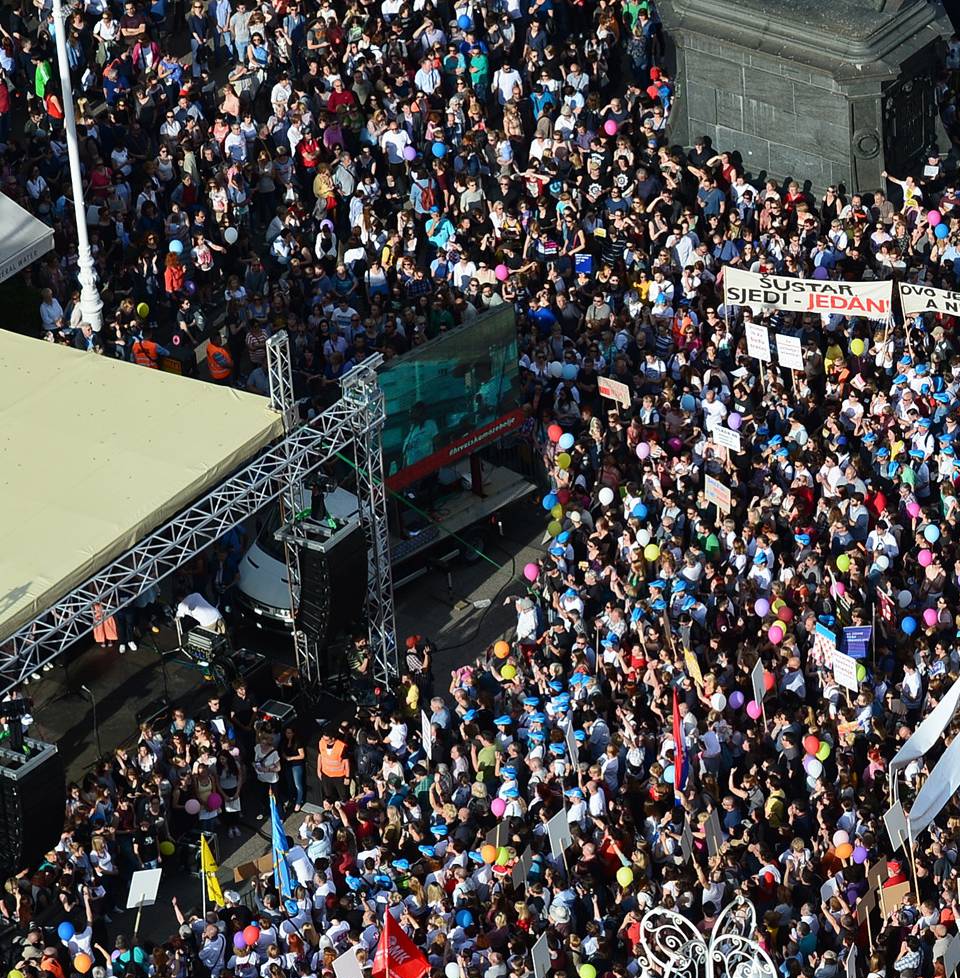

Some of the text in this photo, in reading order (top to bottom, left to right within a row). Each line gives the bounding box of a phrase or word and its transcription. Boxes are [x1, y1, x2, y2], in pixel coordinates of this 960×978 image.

[728, 287, 787, 305] SJEDI
[901, 285, 935, 297] OVO
[926, 299, 937, 309] A
